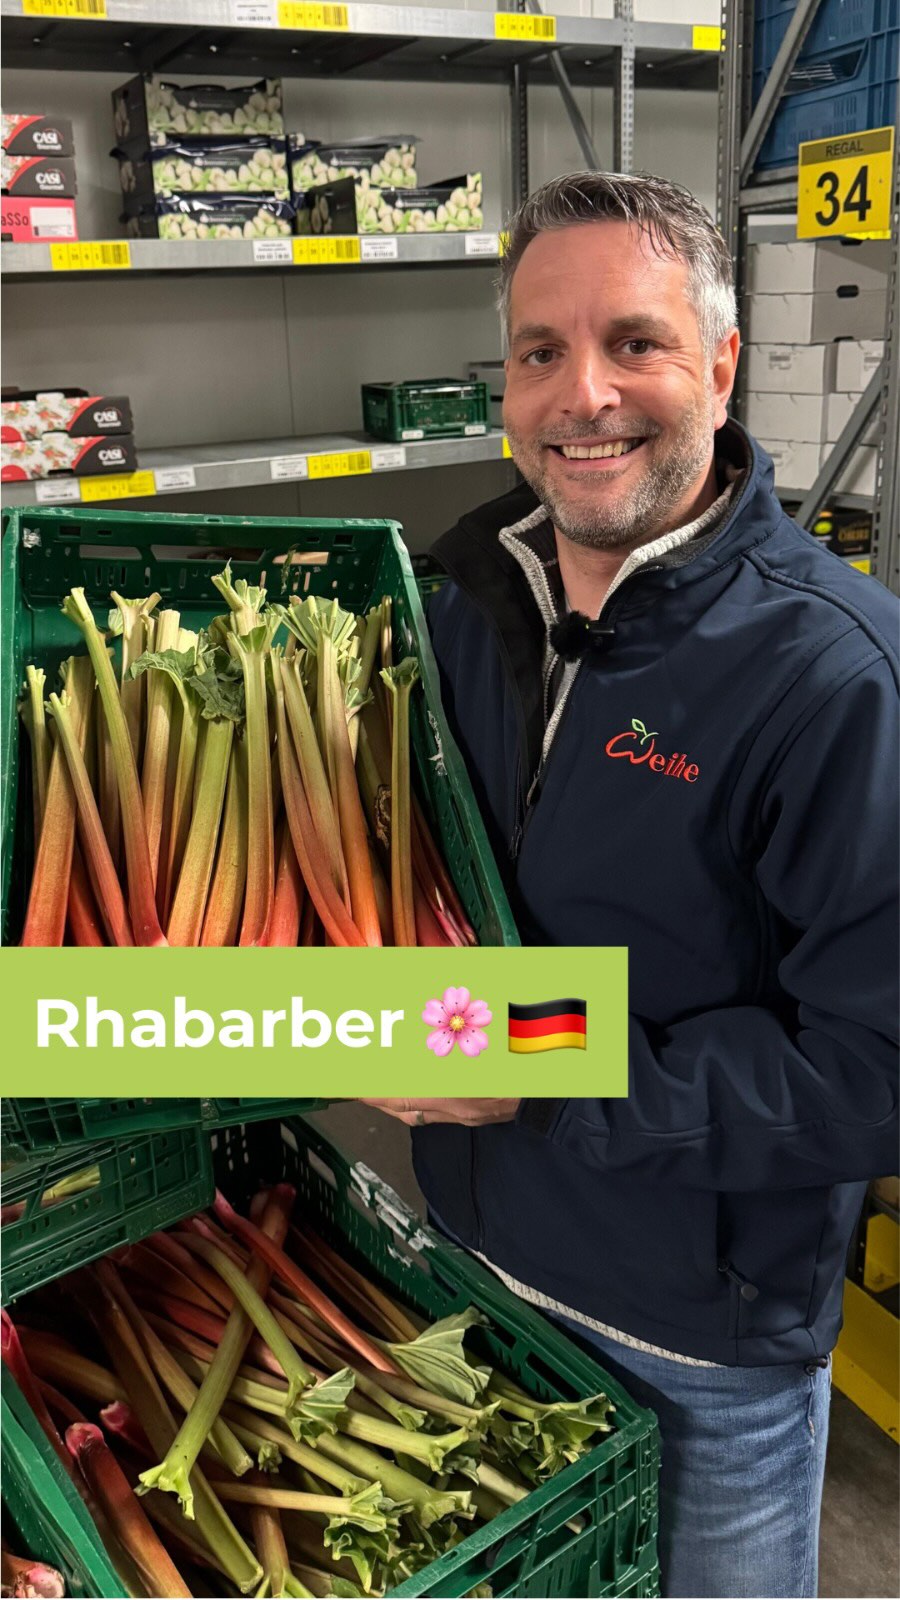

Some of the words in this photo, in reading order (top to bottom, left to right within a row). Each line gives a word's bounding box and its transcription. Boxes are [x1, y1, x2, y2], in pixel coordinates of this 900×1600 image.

[33, 131, 58, 144] CASI
[826, 140, 864, 157] REGAL
[35, 172, 61, 184] CASI
[815, 165, 871, 227] 34
[605, 731, 699, 782] Weihe
